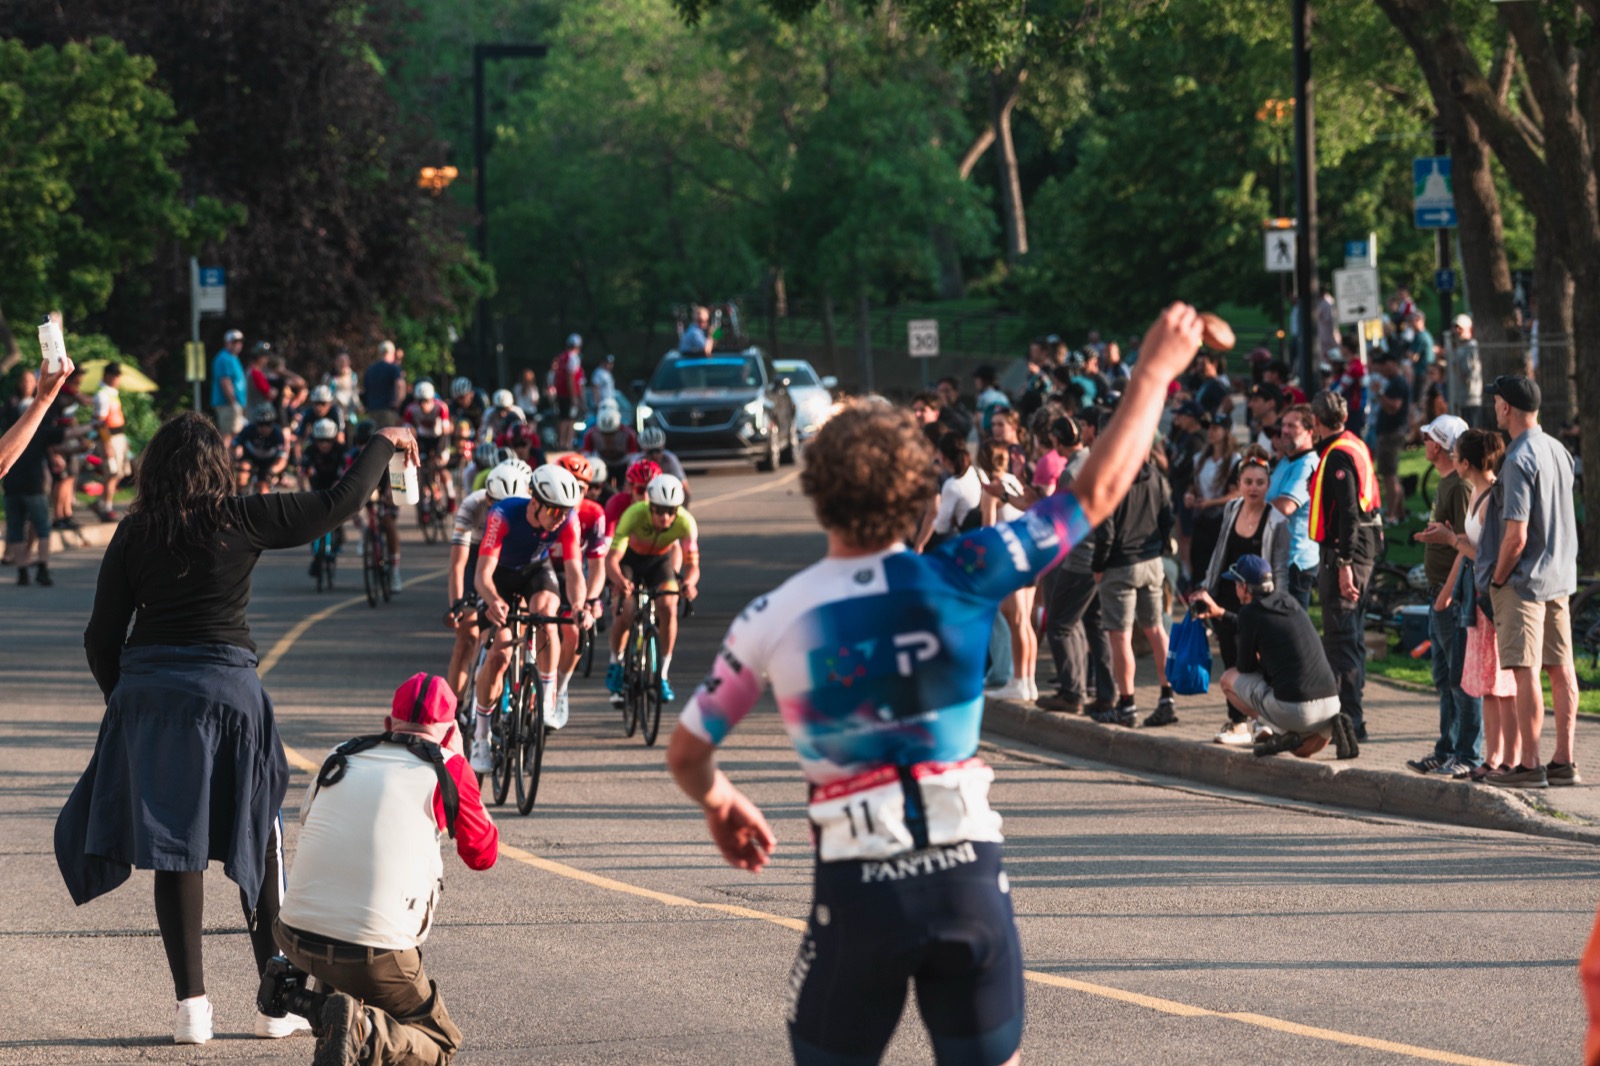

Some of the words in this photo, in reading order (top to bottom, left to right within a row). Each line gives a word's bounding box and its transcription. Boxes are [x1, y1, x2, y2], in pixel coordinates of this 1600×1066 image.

[483, 505, 505, 549] MIDWEEK
[842, 800, 874, 839] 11
[860, 842, 979, 884] FANTINI
